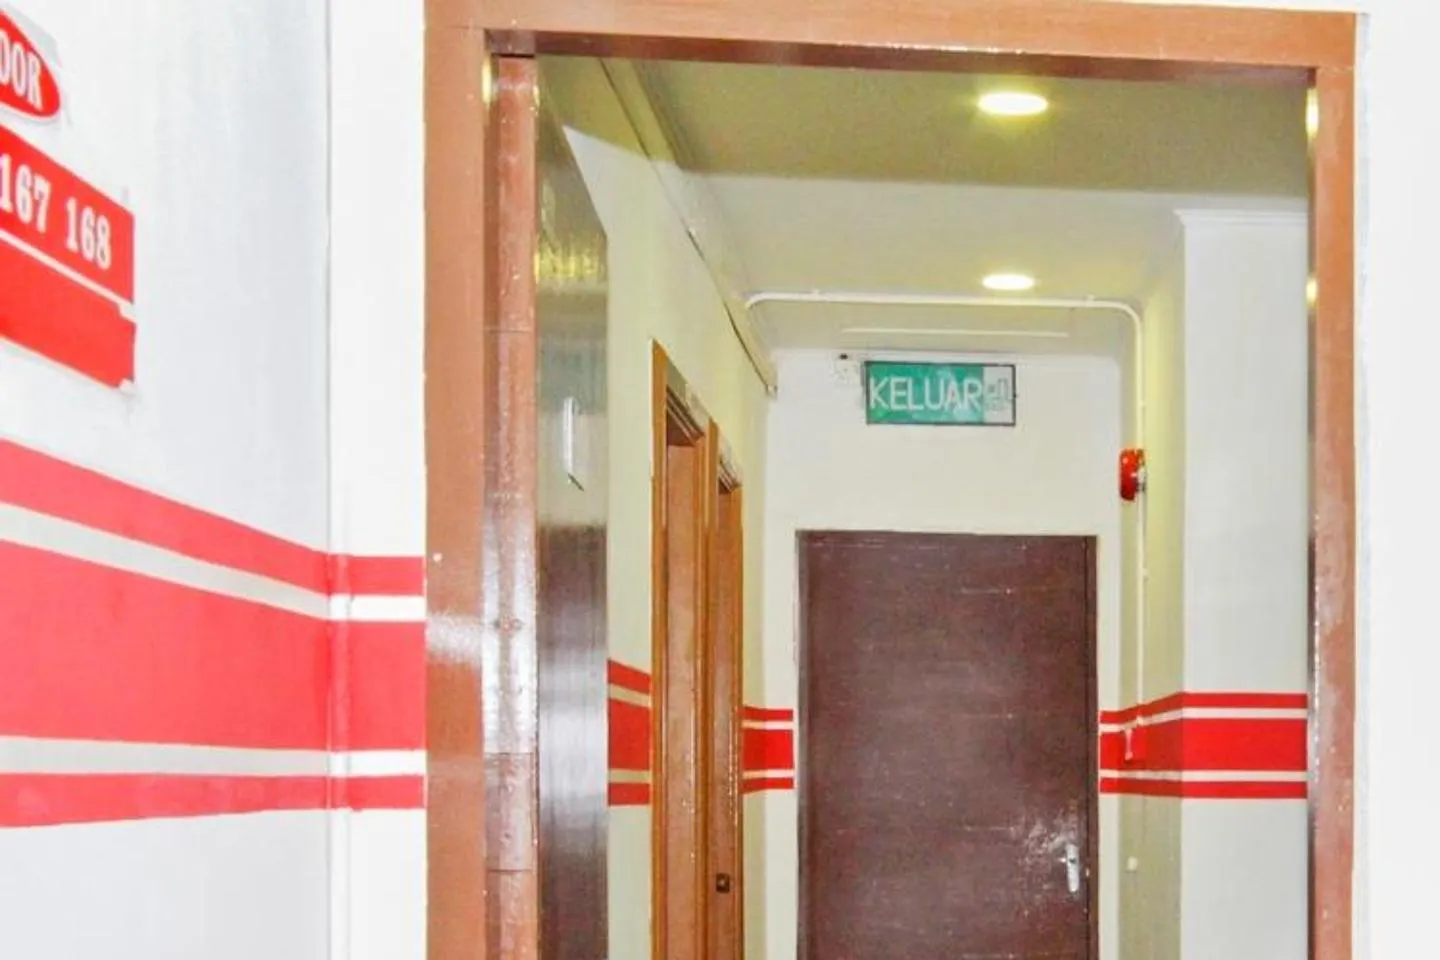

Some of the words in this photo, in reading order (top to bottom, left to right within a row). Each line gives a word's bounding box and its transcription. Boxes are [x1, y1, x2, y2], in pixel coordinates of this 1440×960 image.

[0, 153, 52, 234] 167
[65, 196, 111, 270] 168
[869, 376, 982, 412] KELUAR
